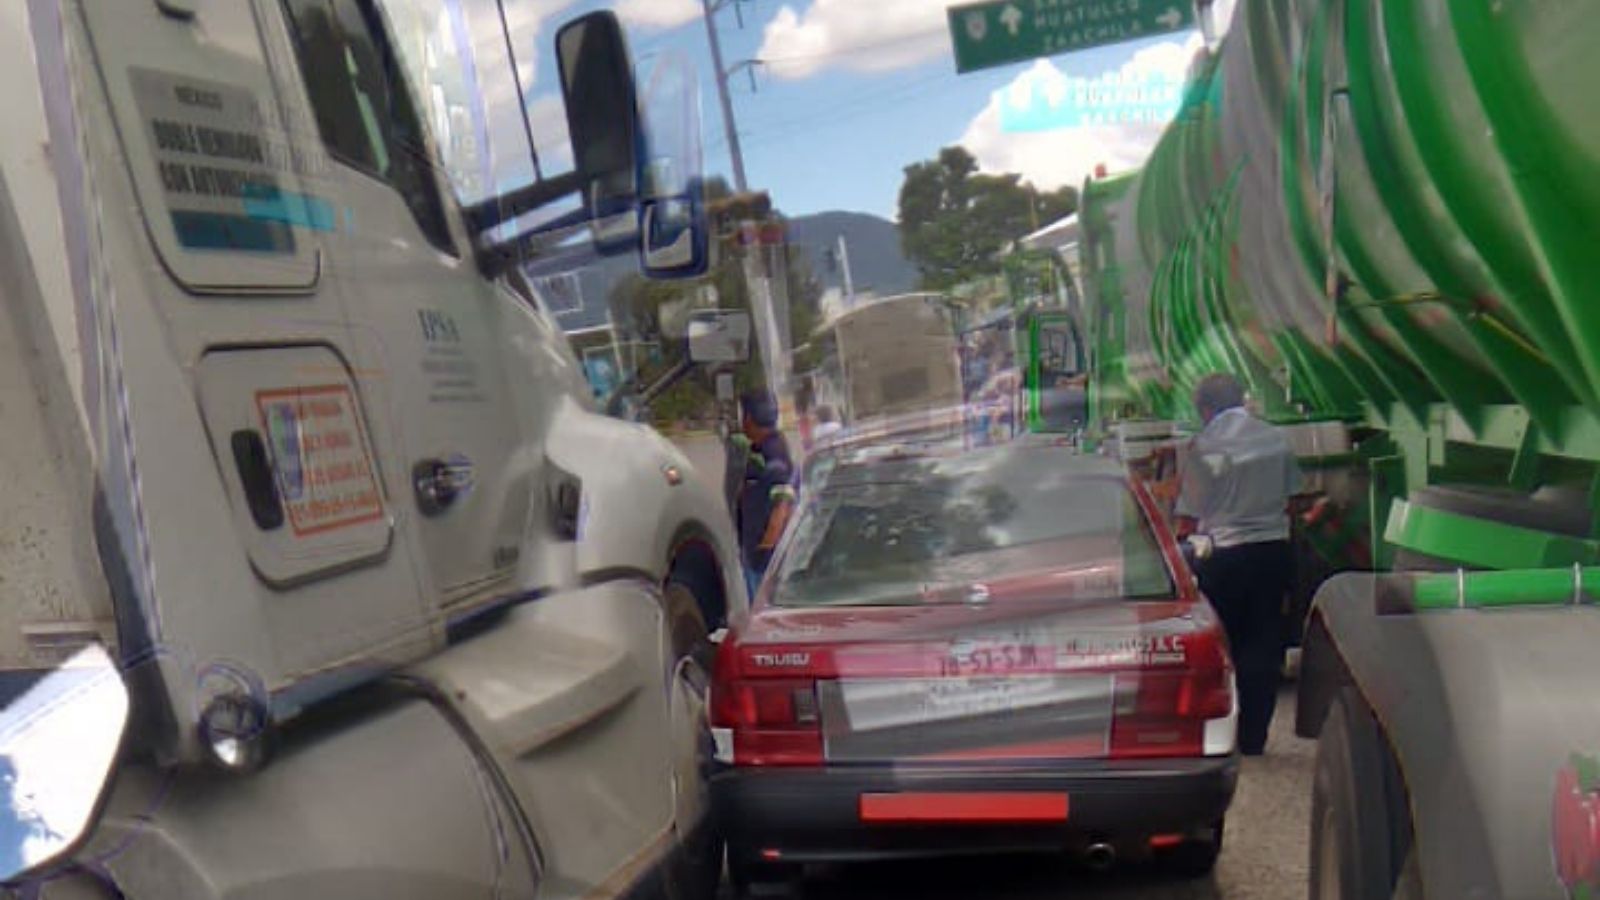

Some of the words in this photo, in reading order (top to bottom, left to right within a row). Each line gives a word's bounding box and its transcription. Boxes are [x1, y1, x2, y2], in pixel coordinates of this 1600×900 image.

[1035, 1, 1139, 27] HUATULCO
[1043, 20, 1142, 49] ZAACHILA
[160, 160, 192, 191] CON
